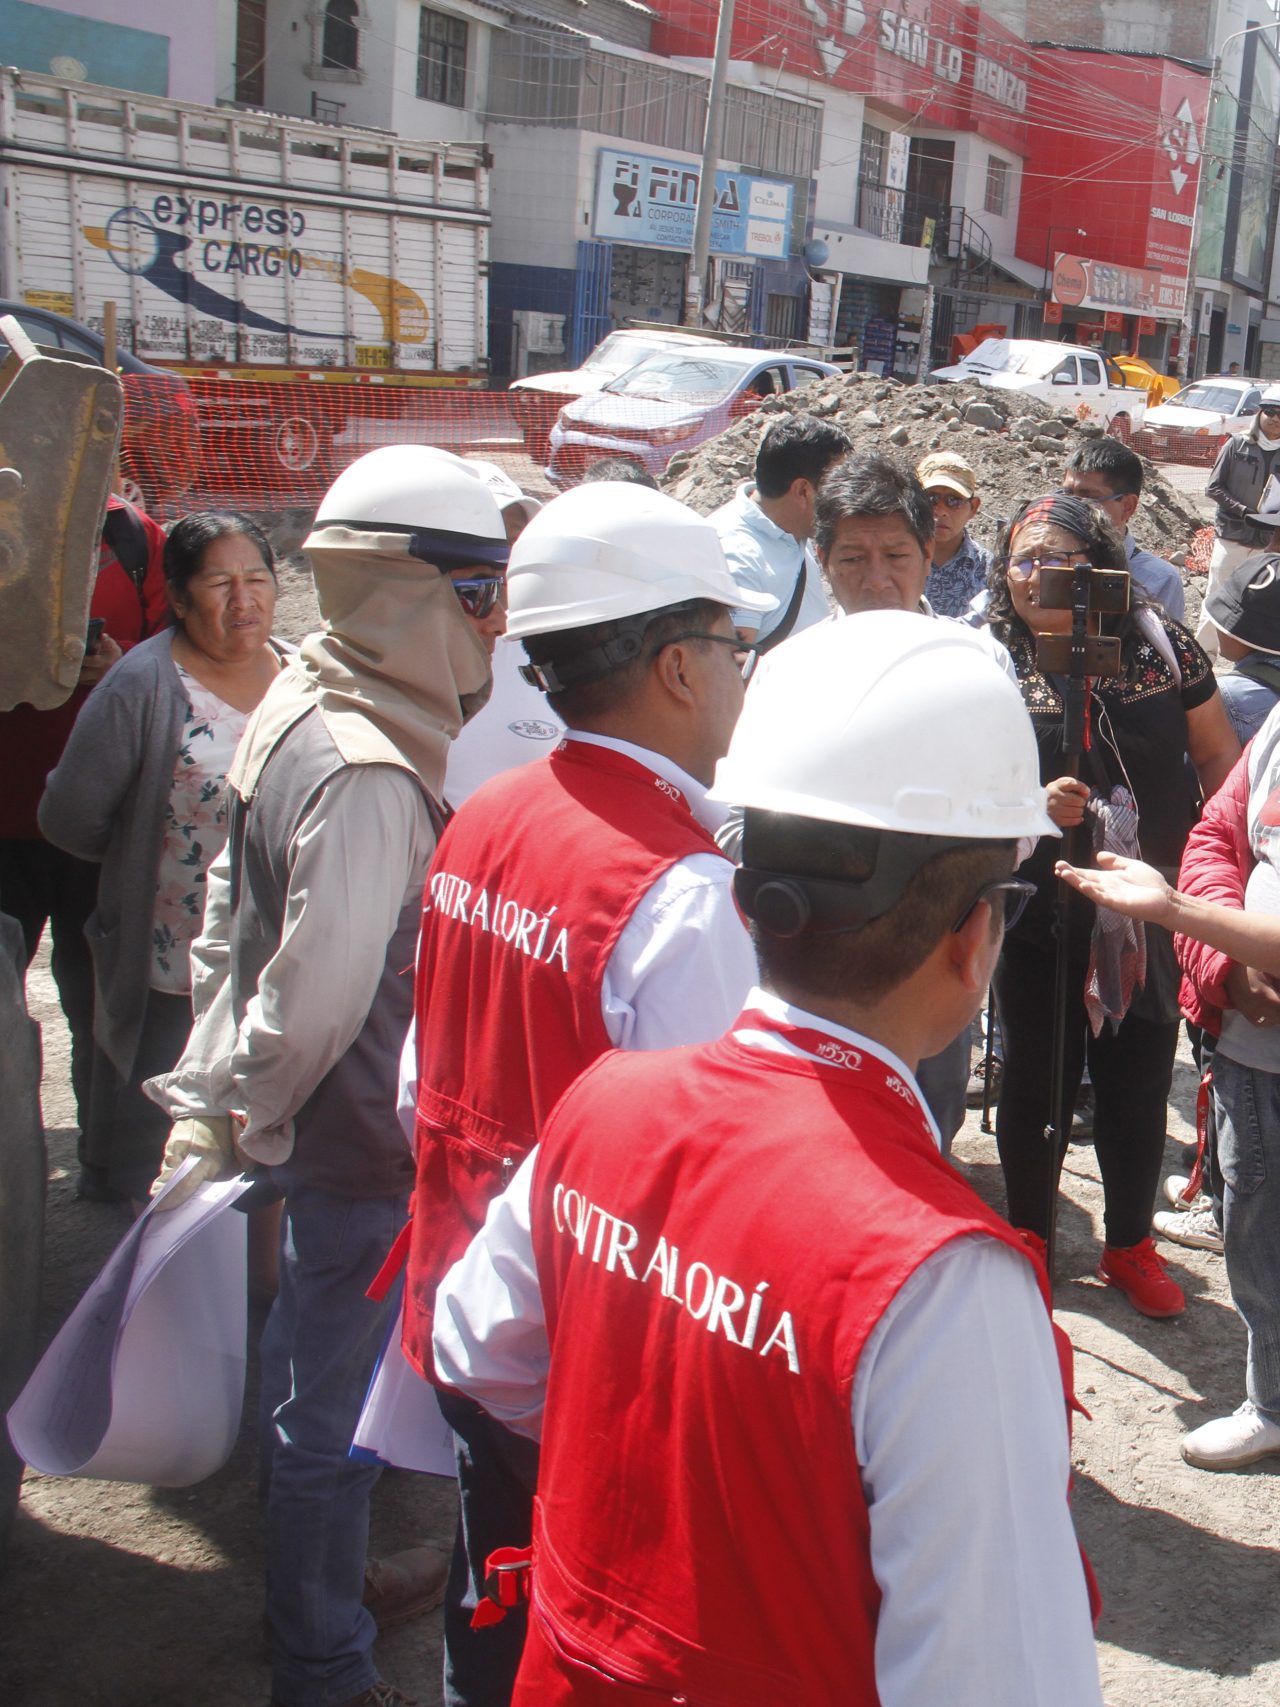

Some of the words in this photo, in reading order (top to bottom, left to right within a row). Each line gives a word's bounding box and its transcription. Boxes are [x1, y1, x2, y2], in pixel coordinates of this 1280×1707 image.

[880, 8, 929, 68] SAN
[154, 195, 306, 237] expreso
[715, 217, 740, 230] SMITH
[1151, 207, 1166, 220] SAN
[204, 240, 302, 277] CARGO
[1056, 274, 1082, 288] Chema
[552, 1182, 800, 1374] CONTRALORÍA
